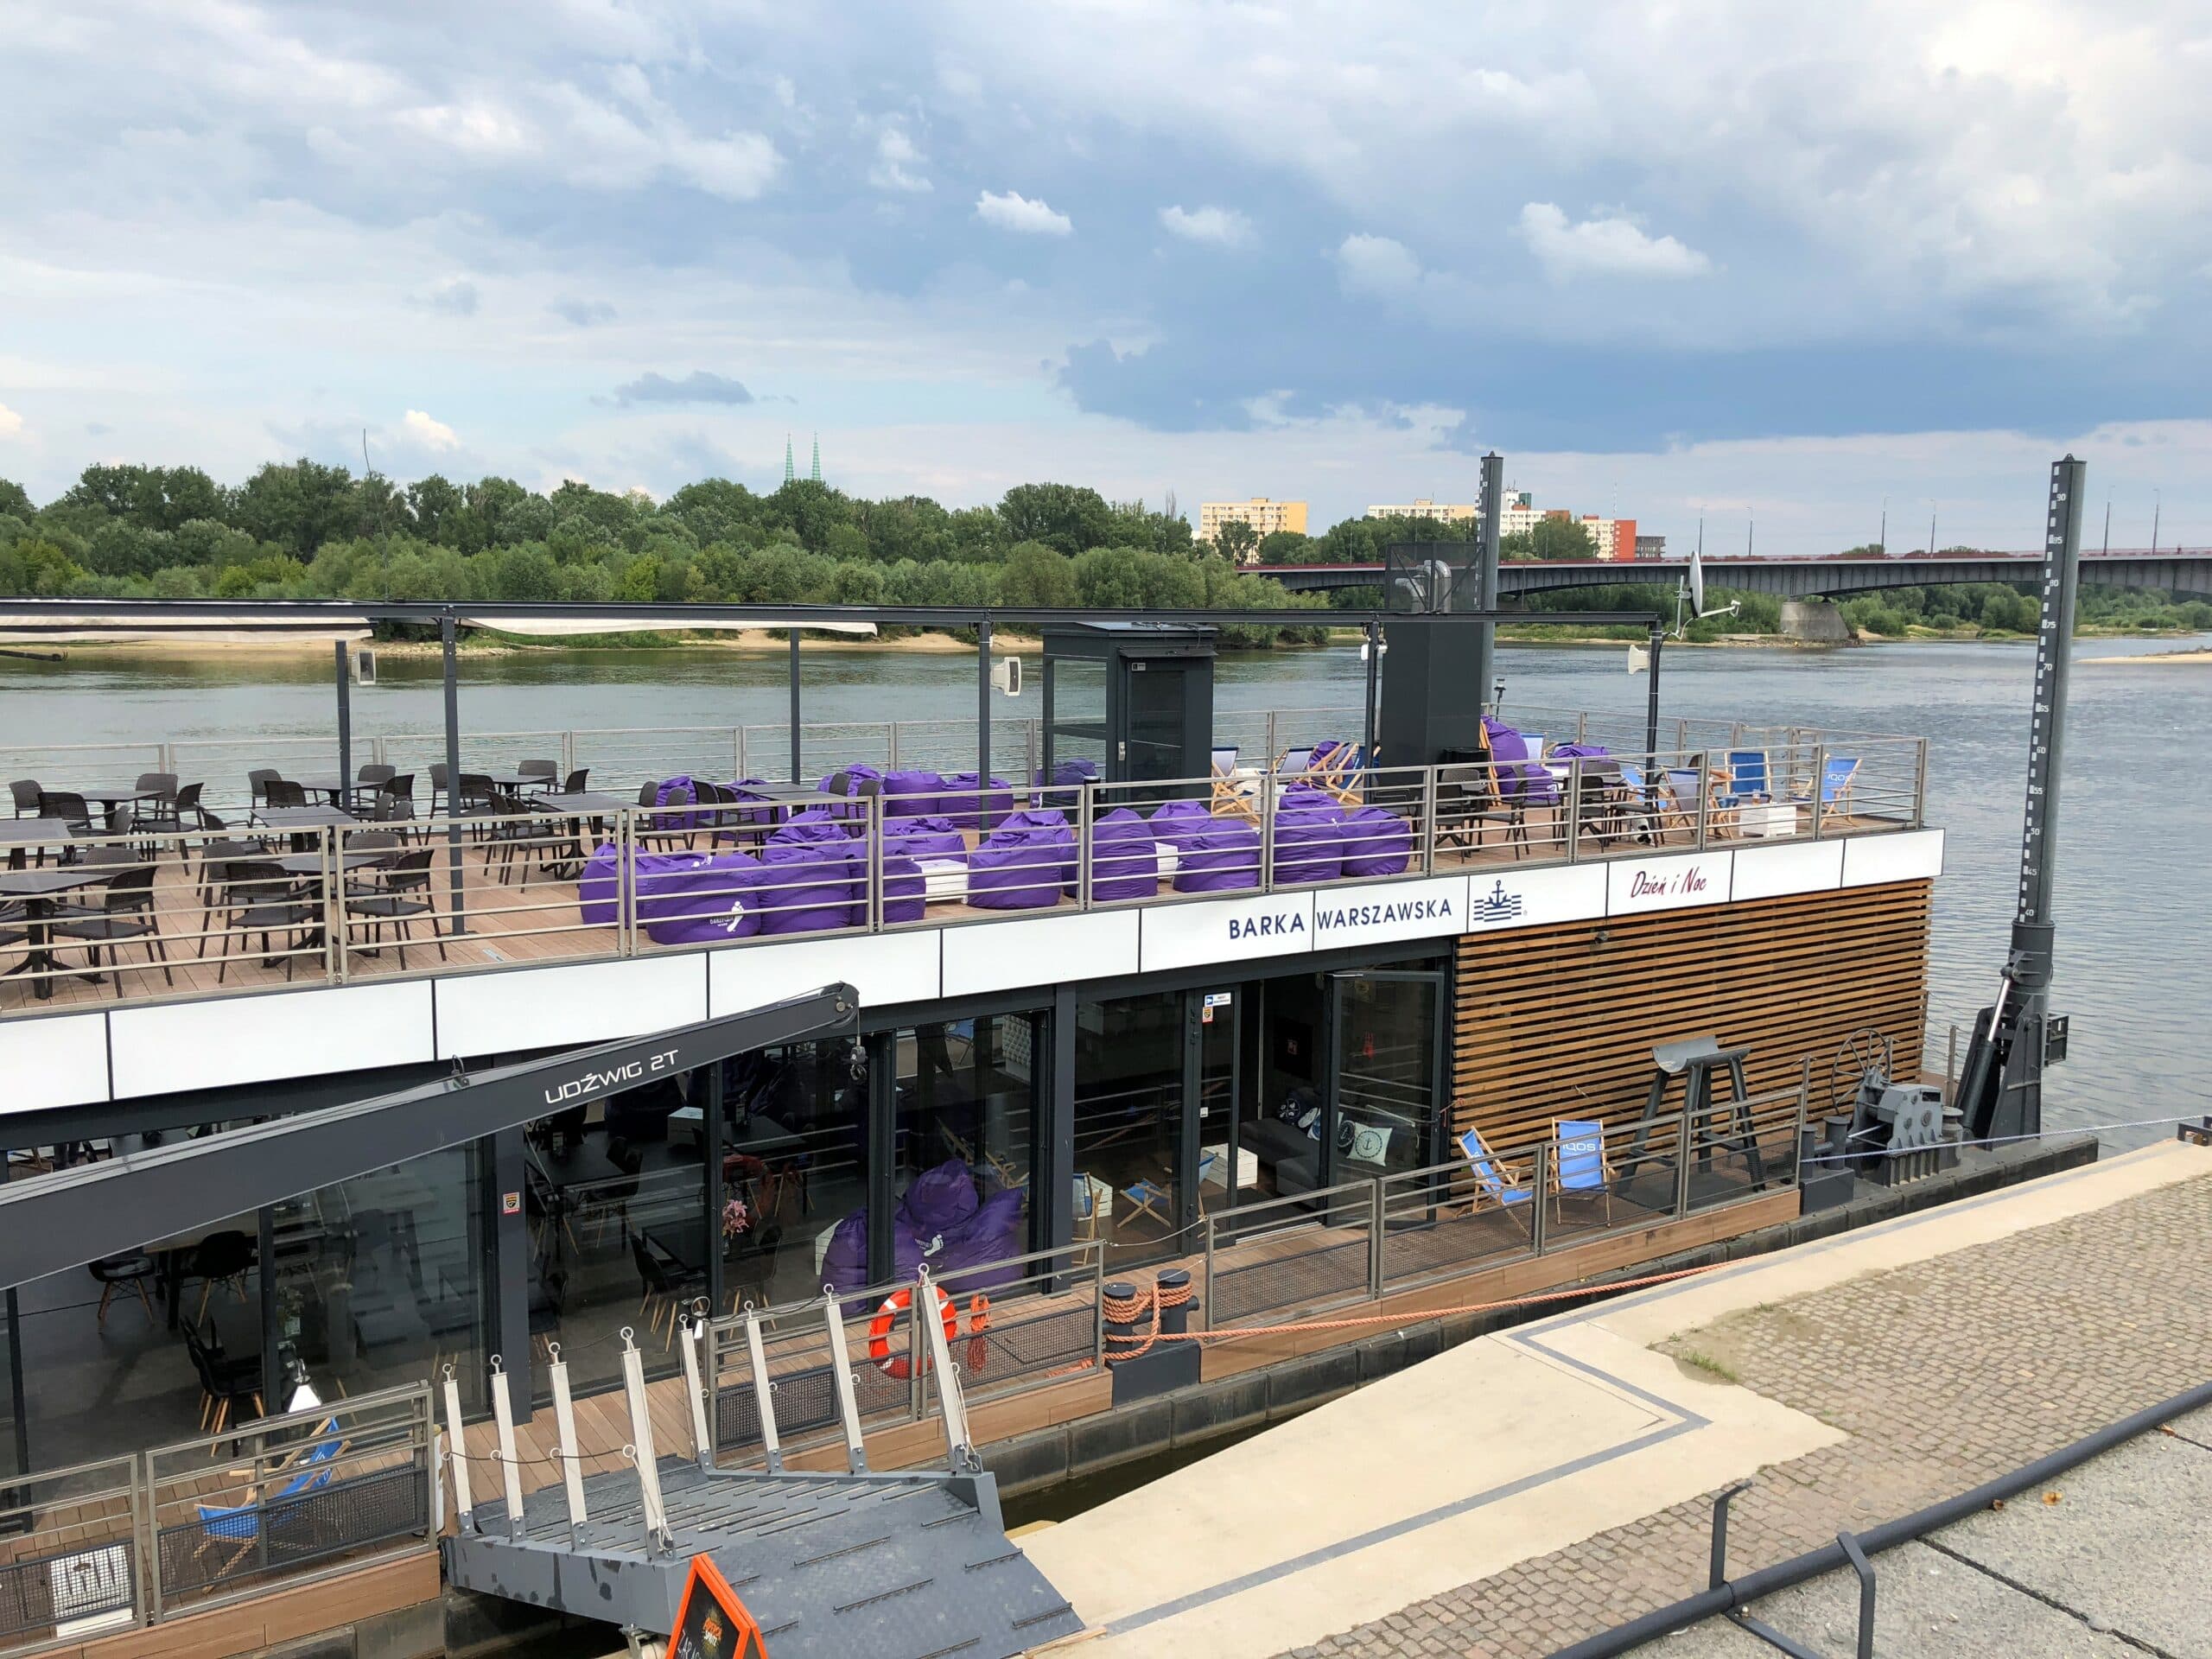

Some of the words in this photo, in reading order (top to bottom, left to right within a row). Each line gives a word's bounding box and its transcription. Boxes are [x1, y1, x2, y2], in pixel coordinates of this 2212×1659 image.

[1630, 870, 1667, 898] Dzień
[1670, 874, 1681, 893] i
[1680, 866, 1707, 893] Noc
[1229, 912, 1306, 940] BARKA
[1316, 898, 1452, 931] WARSZAWSKA
[544, 1060, 643, 1104] UDŹWIG
[650, 1049, 679, 1071] 2T
